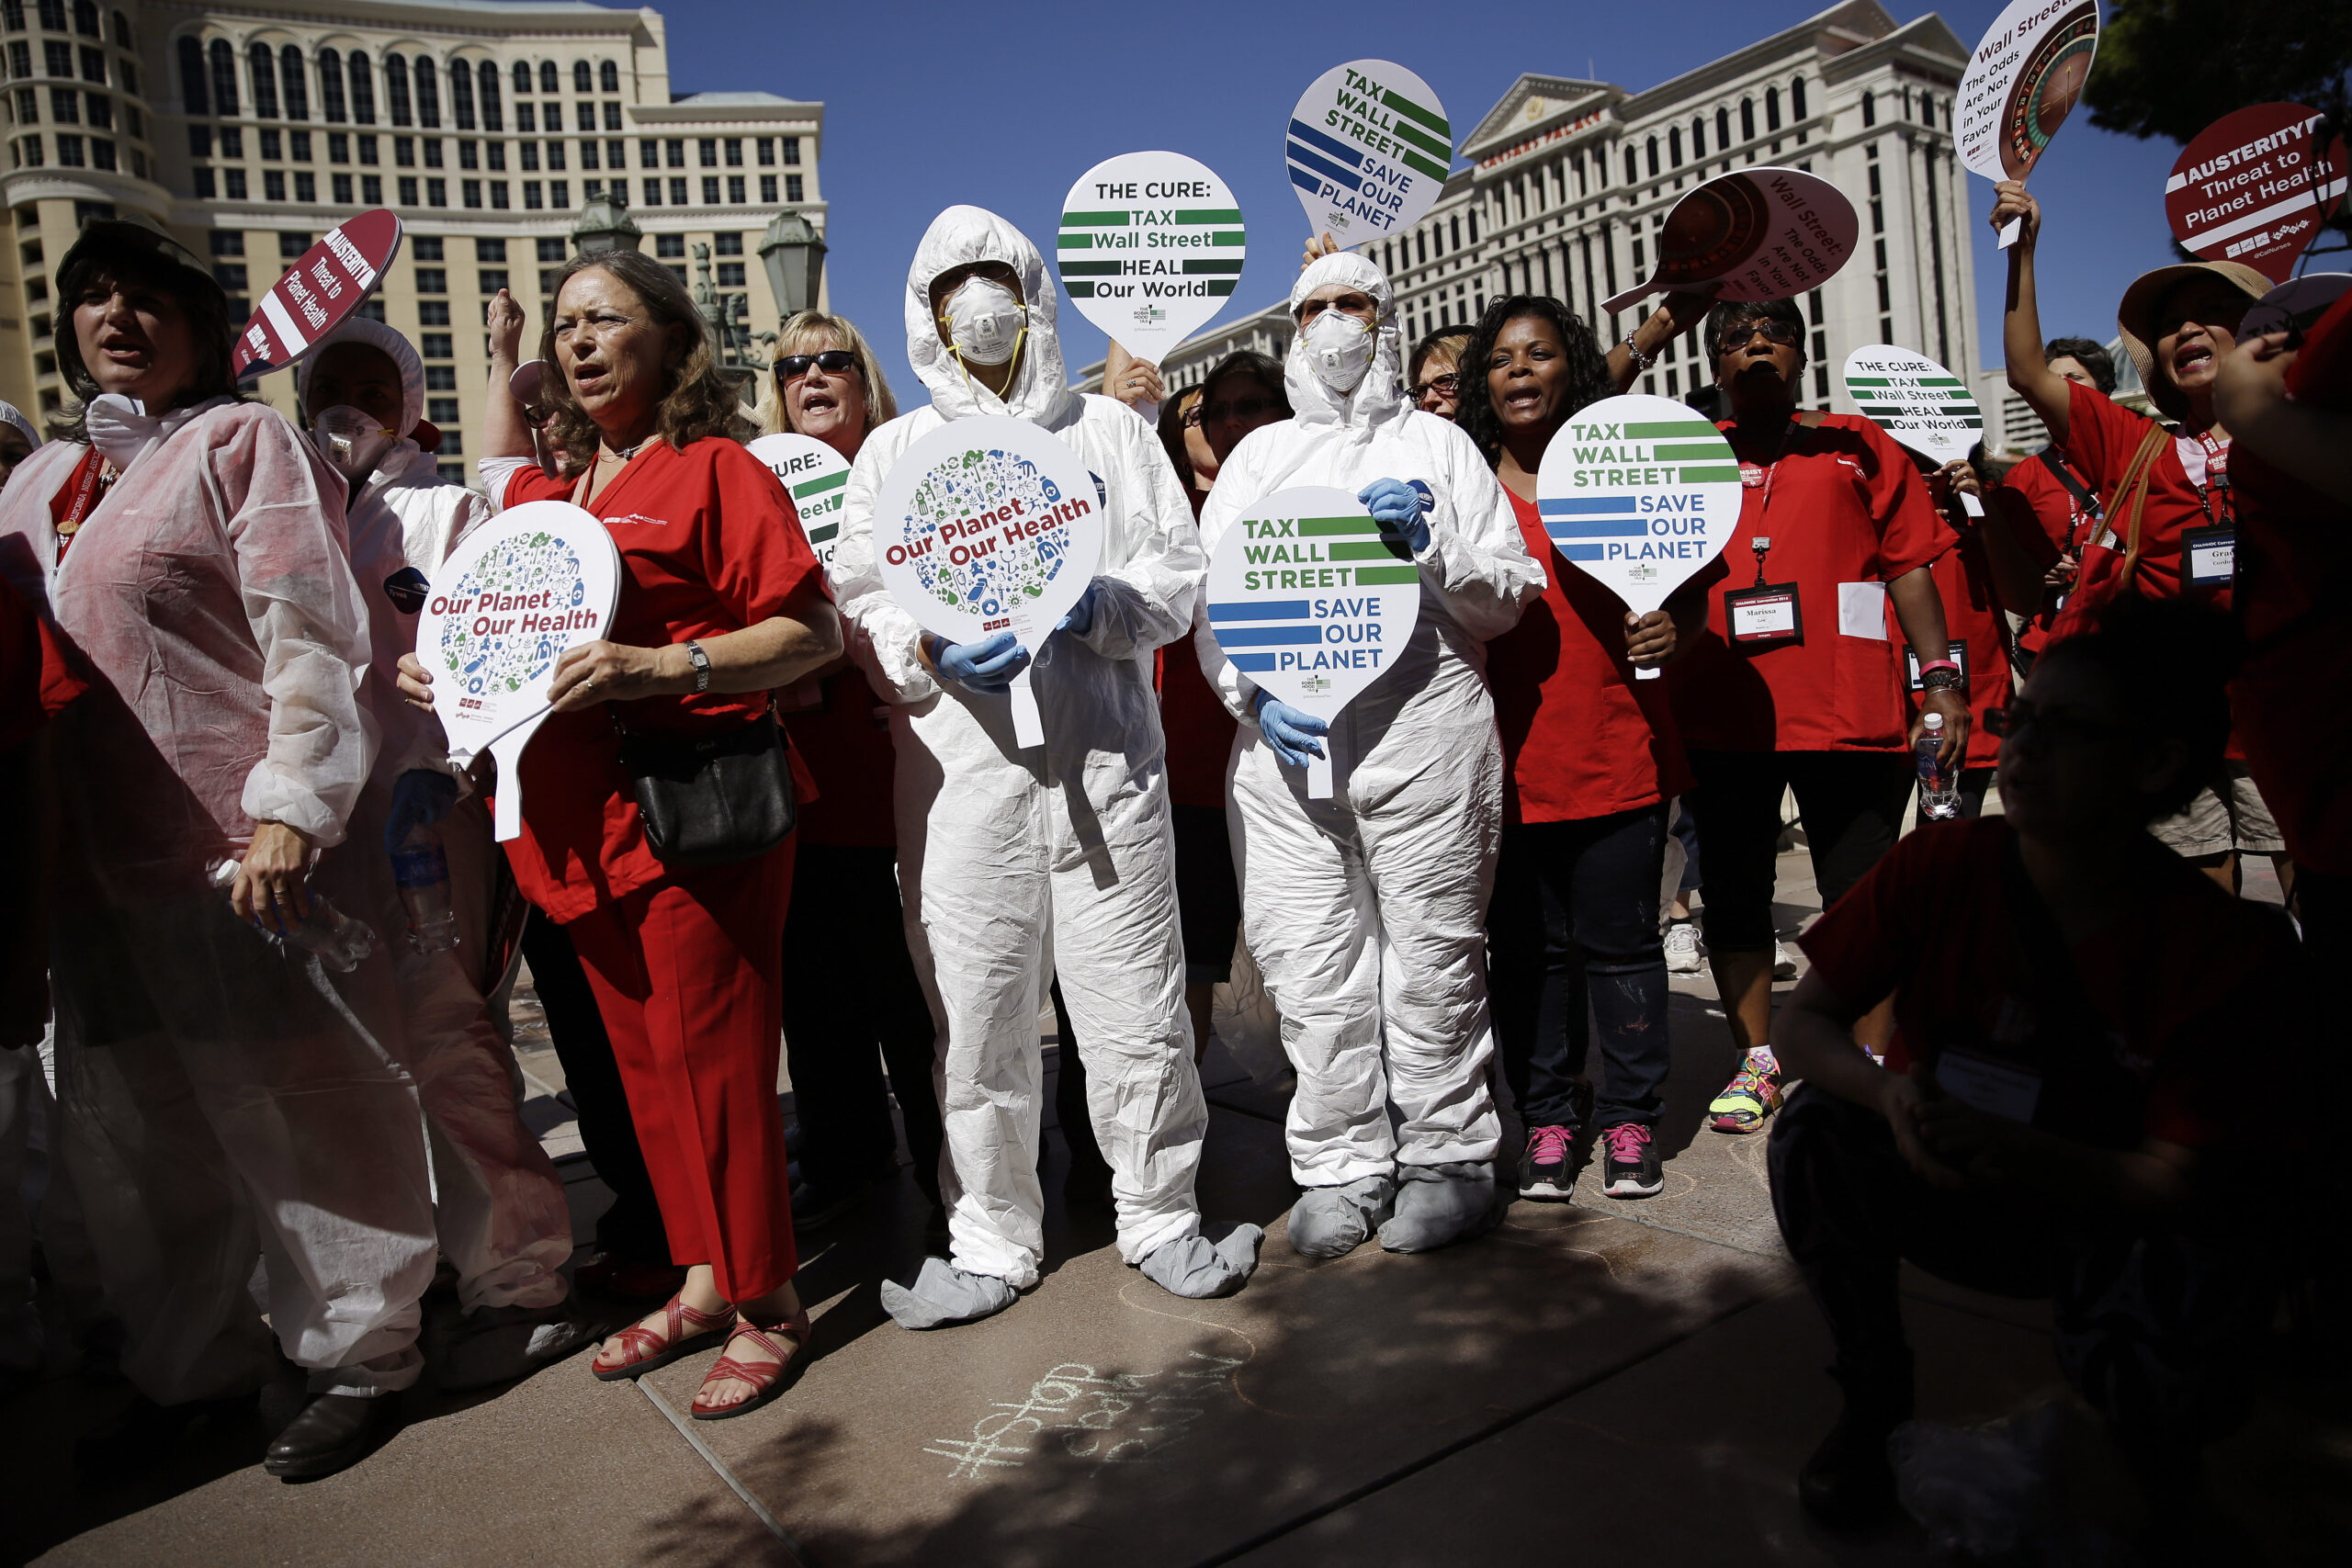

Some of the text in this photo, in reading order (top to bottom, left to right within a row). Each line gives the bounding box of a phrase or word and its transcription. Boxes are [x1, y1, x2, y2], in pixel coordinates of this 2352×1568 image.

[1978, 29, 2012, 63] Wall
[1965, 73, 1985, 92] The
[1989, 50, 2019, 76] Odds
[1345, 67, 1384, 101] TAX
[1964, 75, 2008, 110] Are Not
[1336, 88, 1391, 132] WALL
[1963, 97, 2003, 129] in Your
[1325, 109, 1405, 160] STREET
[1962, 121, 1994, 147] Favor
[2188, 120, 2303, 185] AUSTERITY
[1362, 157, 1413, 195] SAVE
[2201, 152, 2301, 199] Threat to
[1096, 181, 1211, 199] THE CURE:
[1362, 182, 1404, 214] OUR
[2185, 160, 2334, 229] Planet Health
[1132, 209, 1173, 226] TAX
[1319, 182, 1396, 231] PLANET
[1770, 175, 1843, 255] Wall Street:
[1094, 231, 1211, 248] Wall Street
[1784, 228, 1827, 274] The Odds
[328, 234, 371, 280] AUSTERITY
[1123, 259, 1181, 276] HEAL
[1771, 245, 1811, 282] Are Not
[311, 256, 343, 299] Threat to
[1747, 270, 1774, 297] Favor
[1758, 256, 1770, 268] in
[1769, 265, 1792, 289] Your
[284, 270, 329, 331] Planet Health
[1096, 280, 1207, 299] Our World
[1856, 361, 1932, 372] THE CURE:
[1872, 390, 1951, 400] Wall Street
[1888, 378, 1919, 387] TAX
[1901, 407, 1942, 417] HEAL
[1571, 423, 1621, 441] TAX
[1894, 420, 1967, 430] Our World
[770, 453, 822, 478] URE:
[1572, 446, 1650, 464] WALL
[81, 471, 95, 492] NURSES
[1573, 468, 1676, 488] STREET
[797, 498, 832, 519] eet
[1640, 494, 1705, 513] SAVE
[886, 497, 1025, 566] Our Planet
[949, 498, 1091, 566] Our Health
[1242, 519, 1295, 538] TAX
[1651, 518, 1706, 536] OUR
[1243, 544, 1325, 564] WALL
[1609, 541, 1707, 560] PLANET
[1244, 568, 1351, 591] STREET
[431, 590, 551, 615] Our Planet
[1314, 597, 1382, 618] SAVE
[1747, 608, 1777, 616] Marissa
[472, 608, 598, 637] Our Health
[1325, 624, 1382, 644] OUR
[1280, 649, 1383, 671] PLANET
